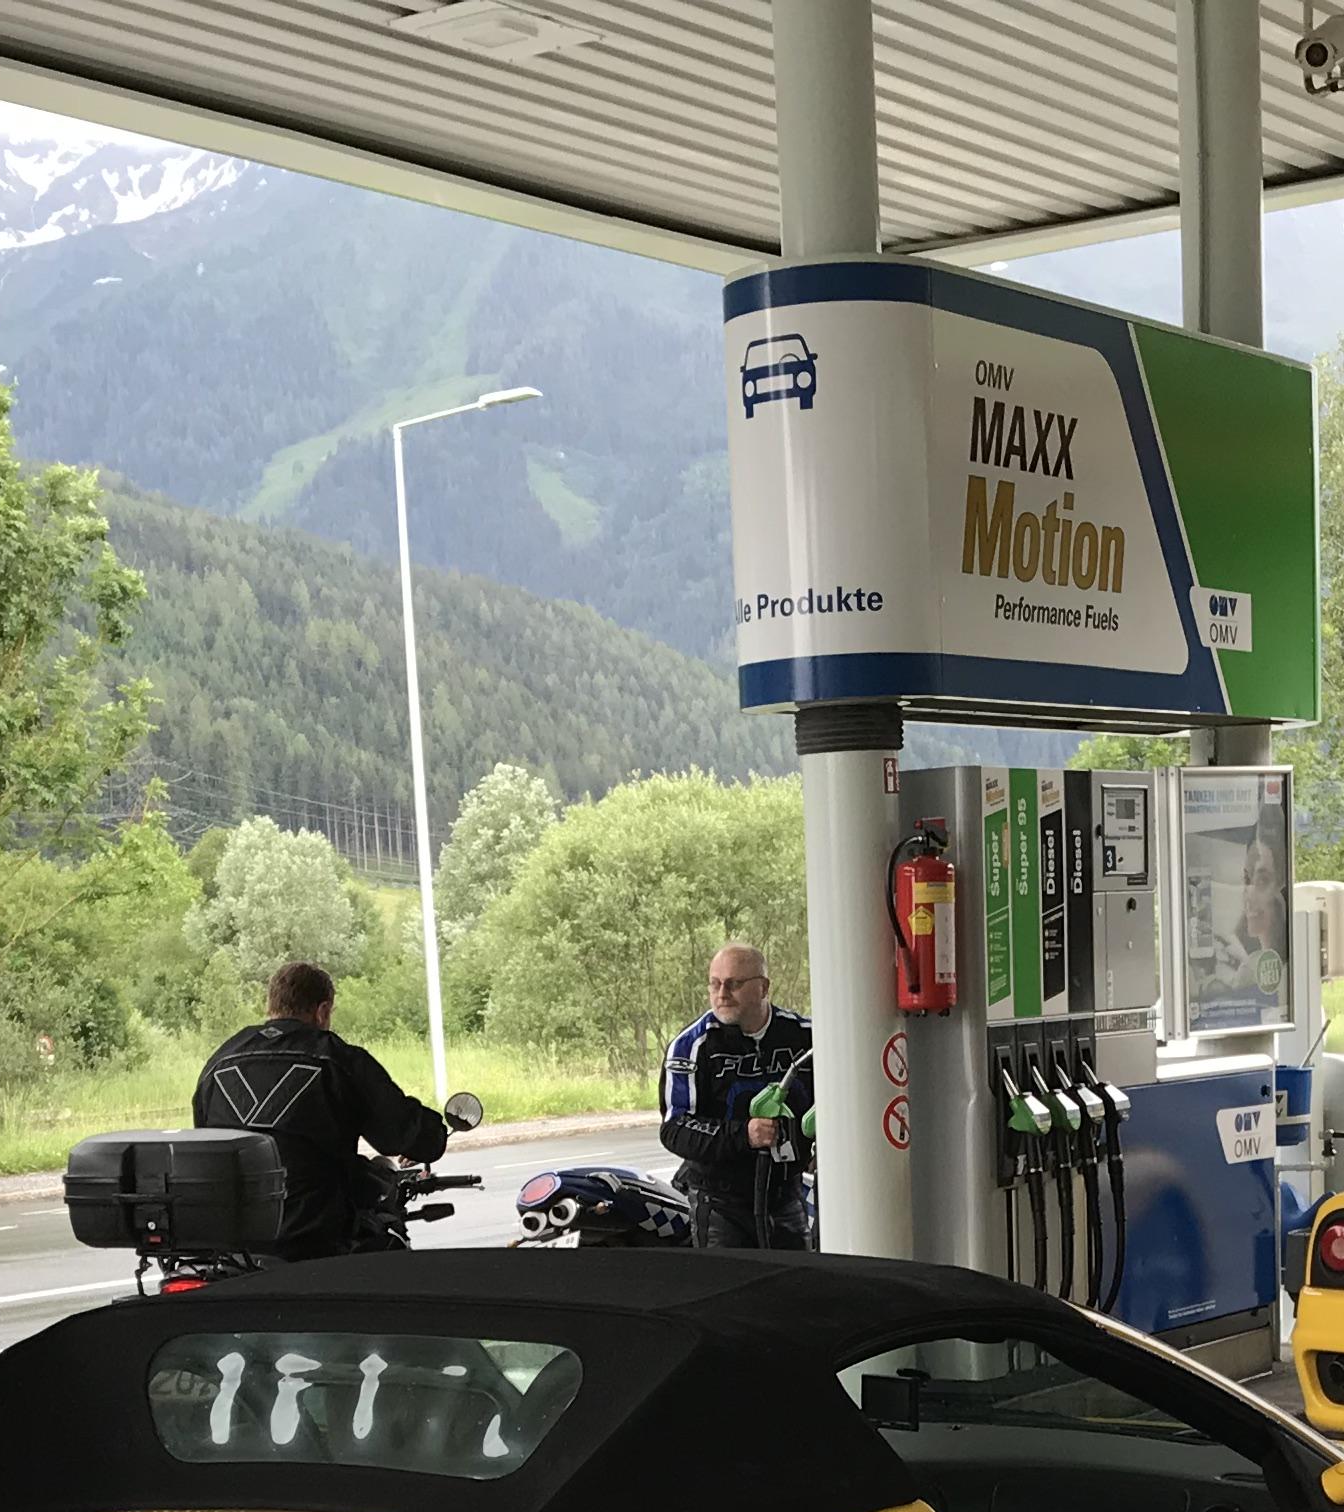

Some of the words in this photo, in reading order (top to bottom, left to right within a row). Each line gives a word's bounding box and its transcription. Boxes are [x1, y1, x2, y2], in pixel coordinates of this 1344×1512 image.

[975, 360, 1014, 391] OMV
[969, 396, 1078, 480] MAXX
[962, 474, 1125, 593] Motion
[757, 586, 884, 620] Produkte
[994, 594, 1081, 628] Performance
[1084, 604, 1119, 631] Fuels
[1209, 623, 1237, 645] OMV
[1017, 798, 1027, 826] 95
[990, 831, 1001, 896] Super
[1019, 831, 1029, 895] Super
[1045, 830, 1055, 895] Diesel
[1072, 830, 1083, 894] Diesel
[1106, 849, 1113, 868] 3
[1234, 1136, 1261, 1158] OMV
